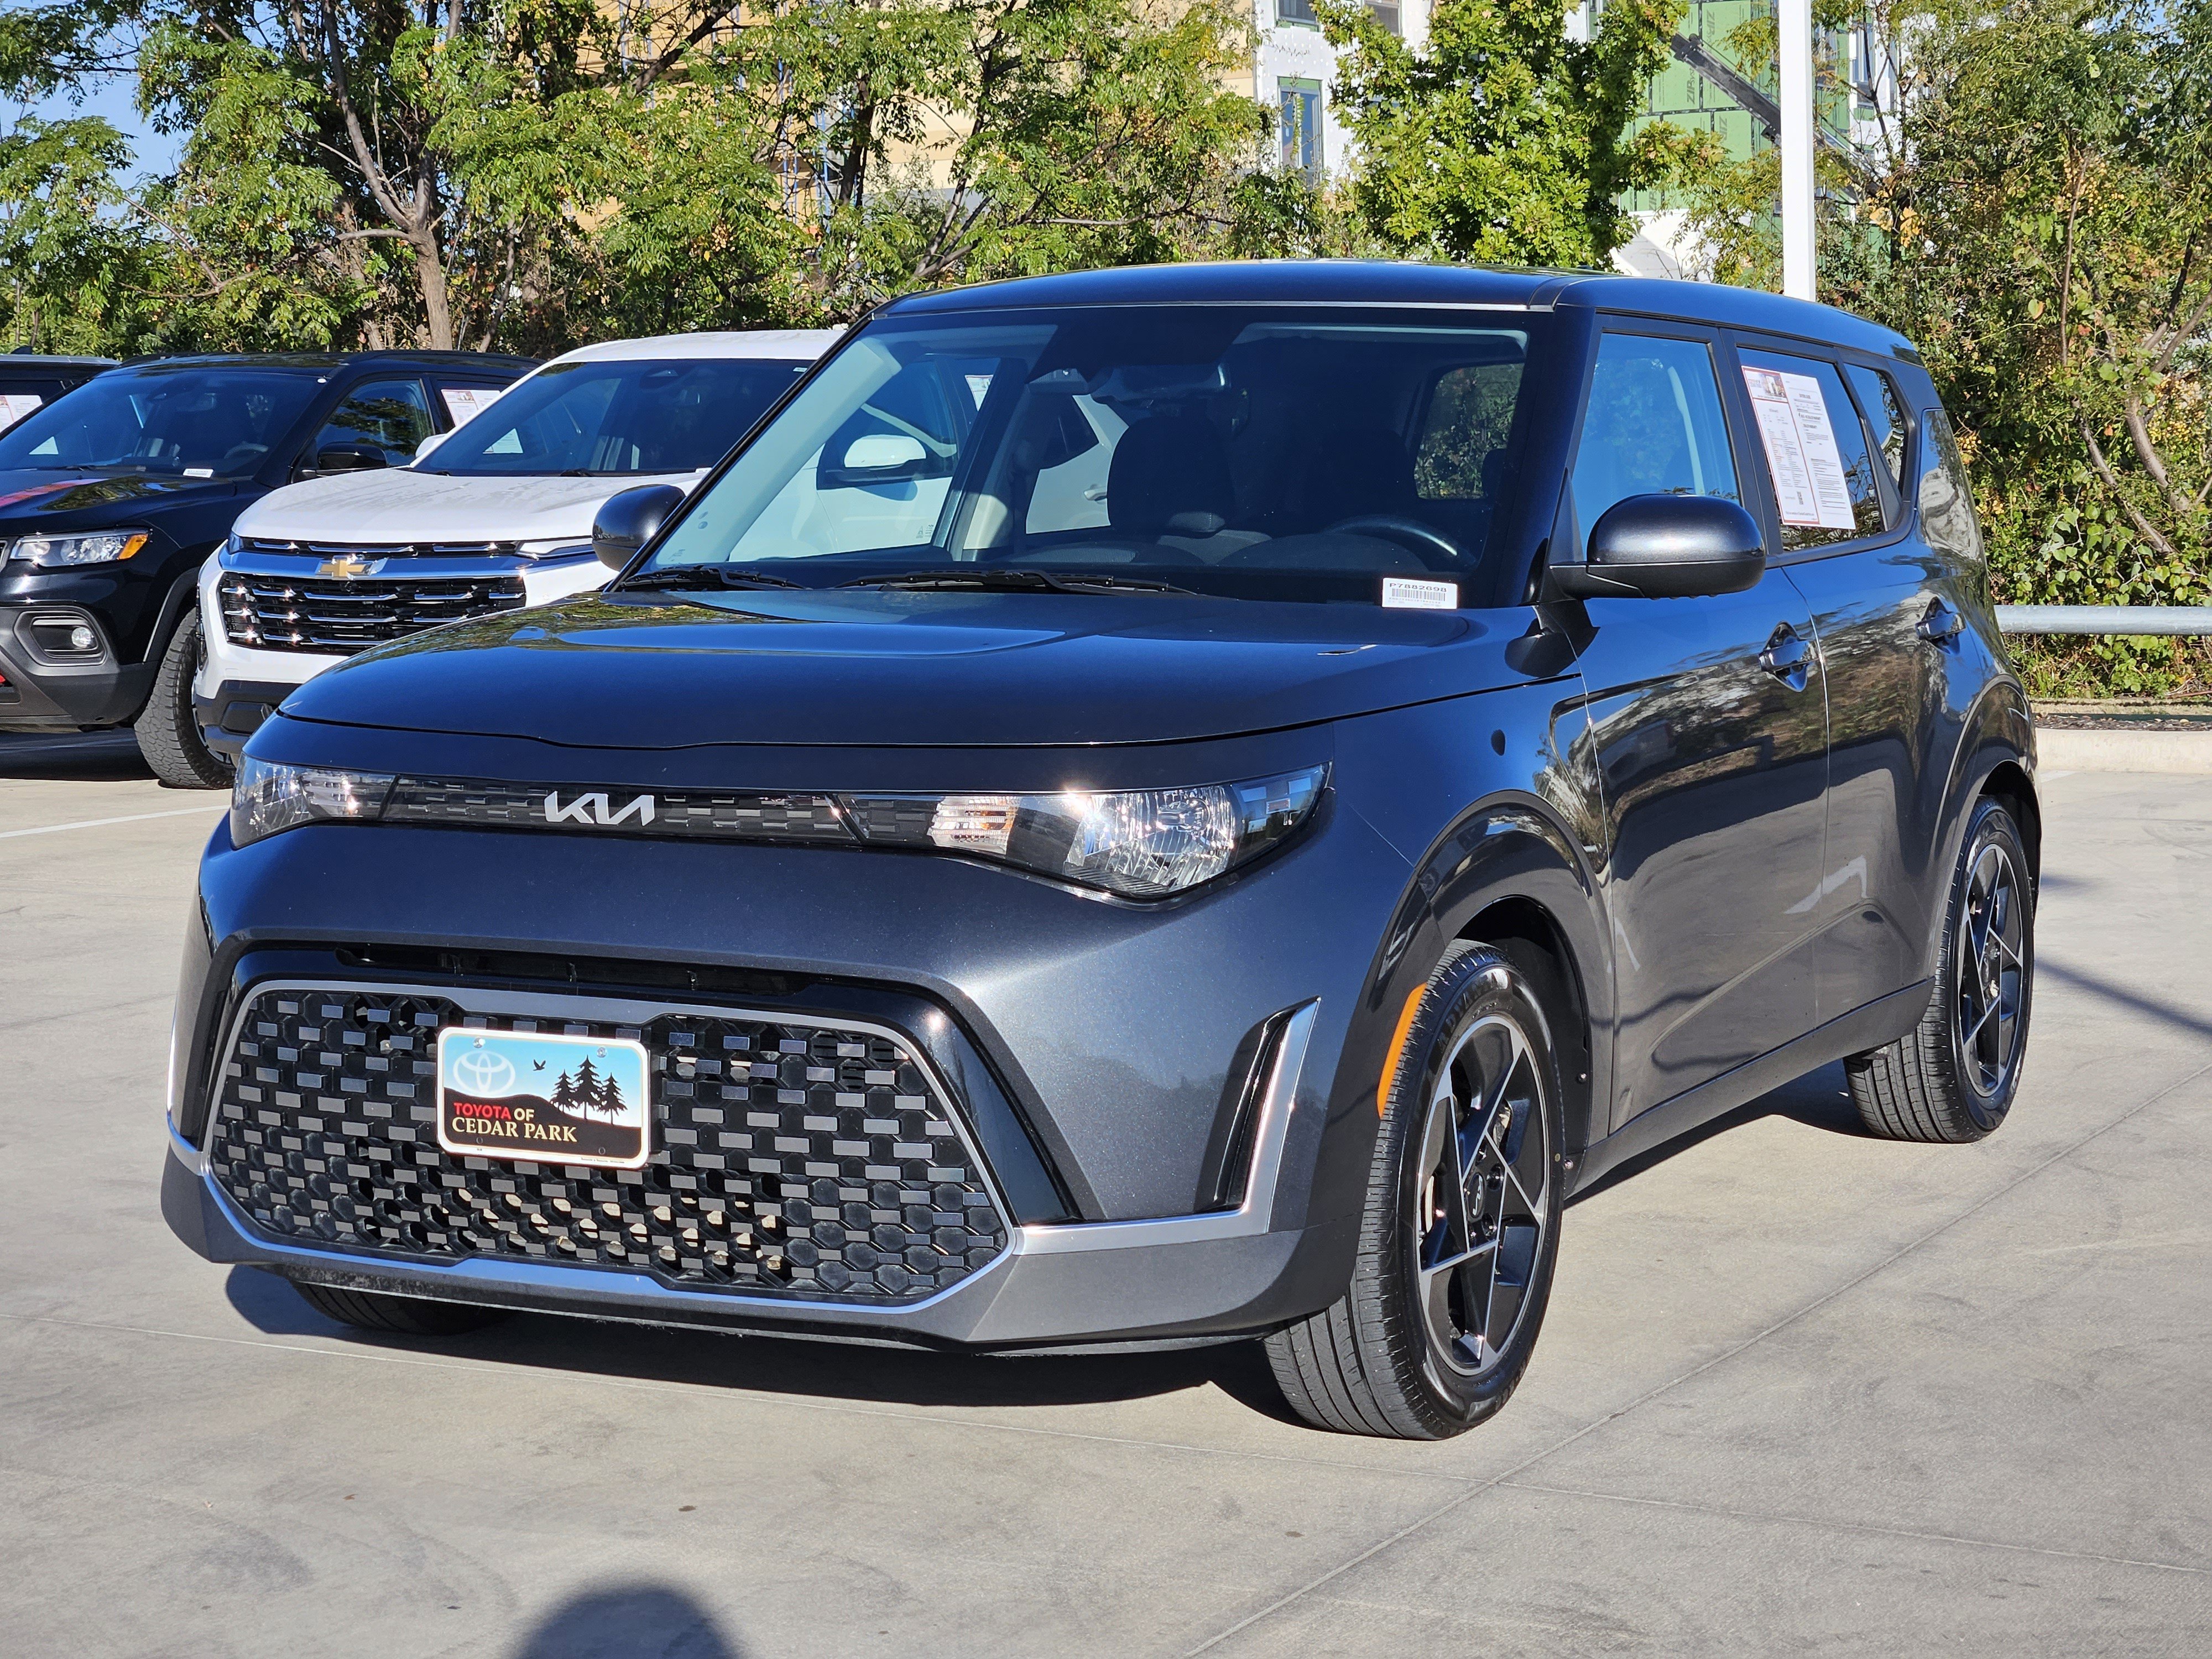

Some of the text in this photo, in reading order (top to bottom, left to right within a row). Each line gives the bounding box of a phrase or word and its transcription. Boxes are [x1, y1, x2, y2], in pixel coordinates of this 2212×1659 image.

[1687, 80, 1696, 105] ZIP
[1390, 583, 1447, 592] P7882698
[544, 790, 655, 826] KIA
[453, 1102, 535, 1121] TOYOTA OF
[452, 1117, 578, 1142] CEDAR PARK
